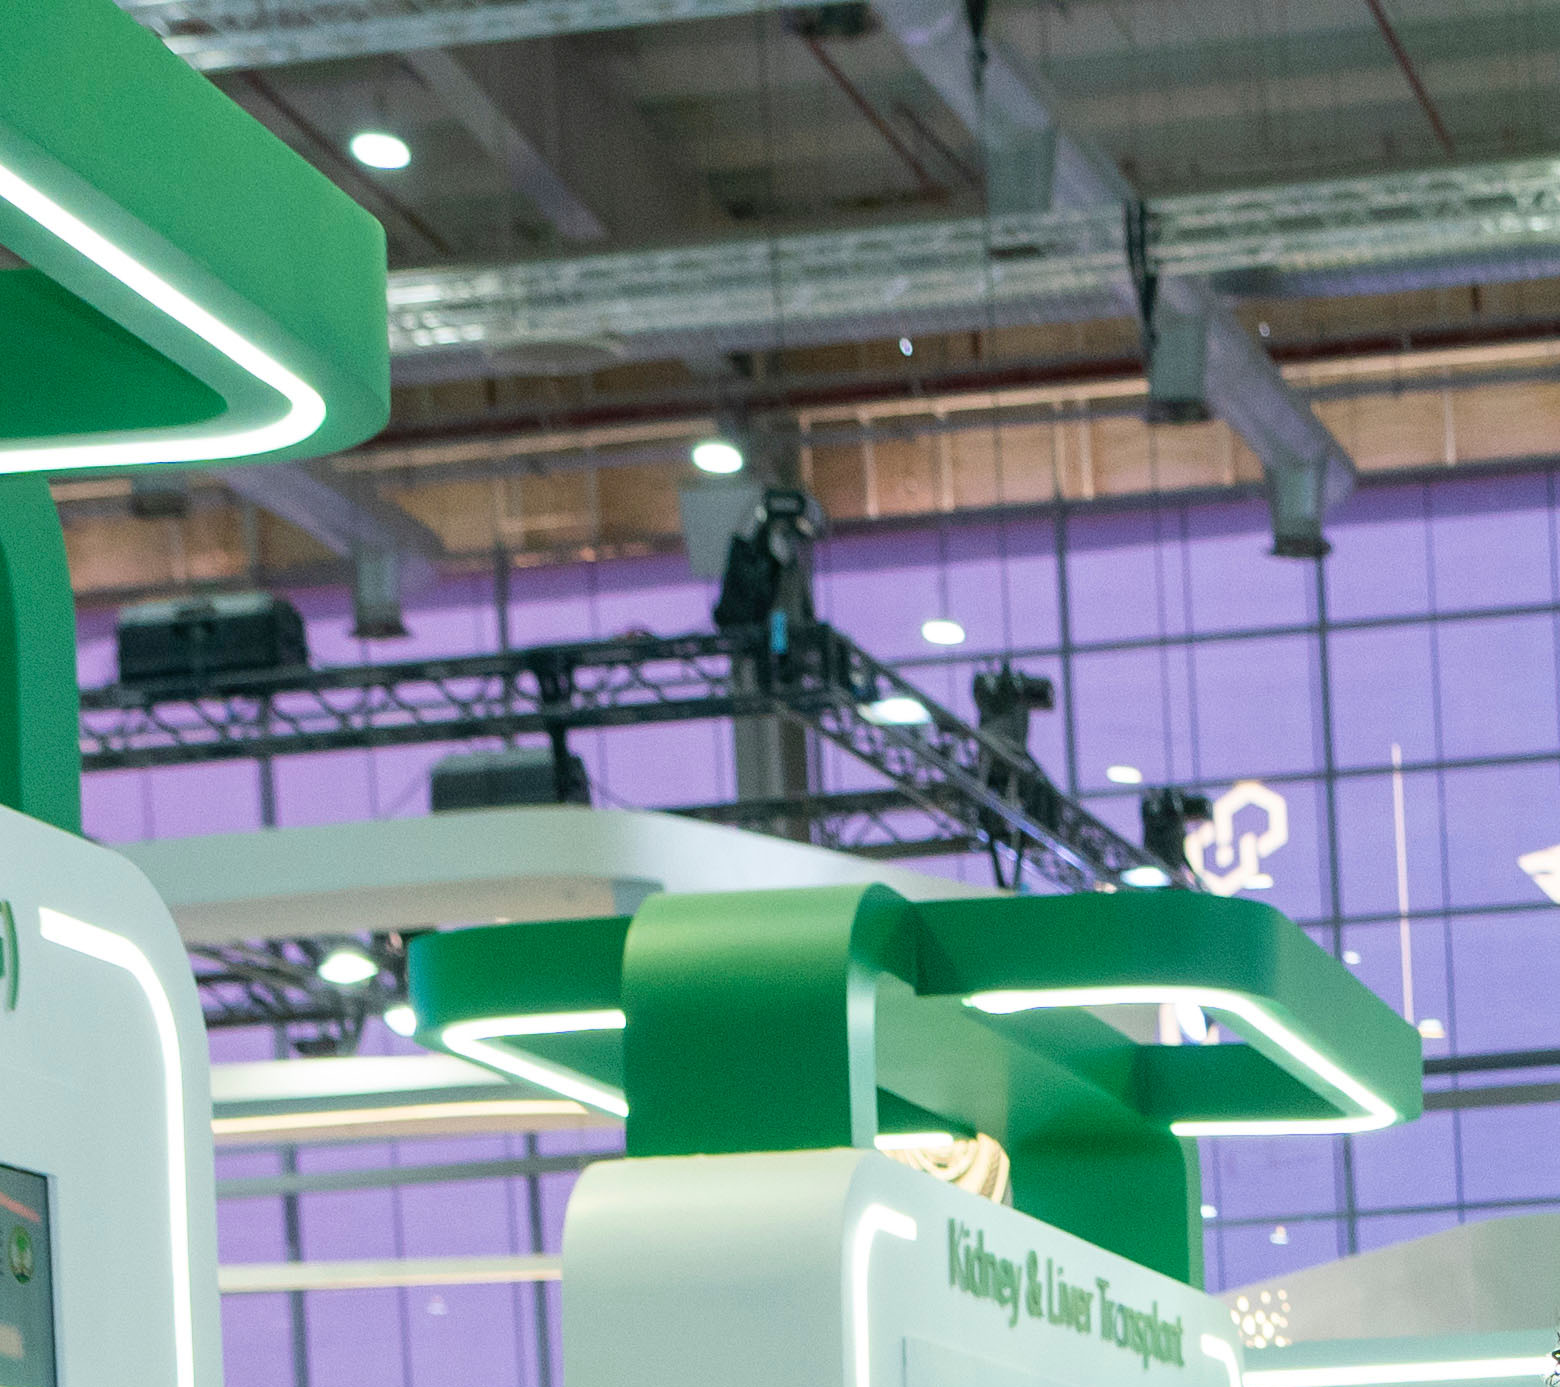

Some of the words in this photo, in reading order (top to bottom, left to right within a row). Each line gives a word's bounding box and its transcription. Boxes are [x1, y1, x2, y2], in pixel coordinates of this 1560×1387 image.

[947, 1217, 1023, 1329] Kidney
[1024, 1249, 1044, 1319] &
[1046, 1257, 1094, 1335] Liver
[1095, 1275, 1185, 1371] Transplant
